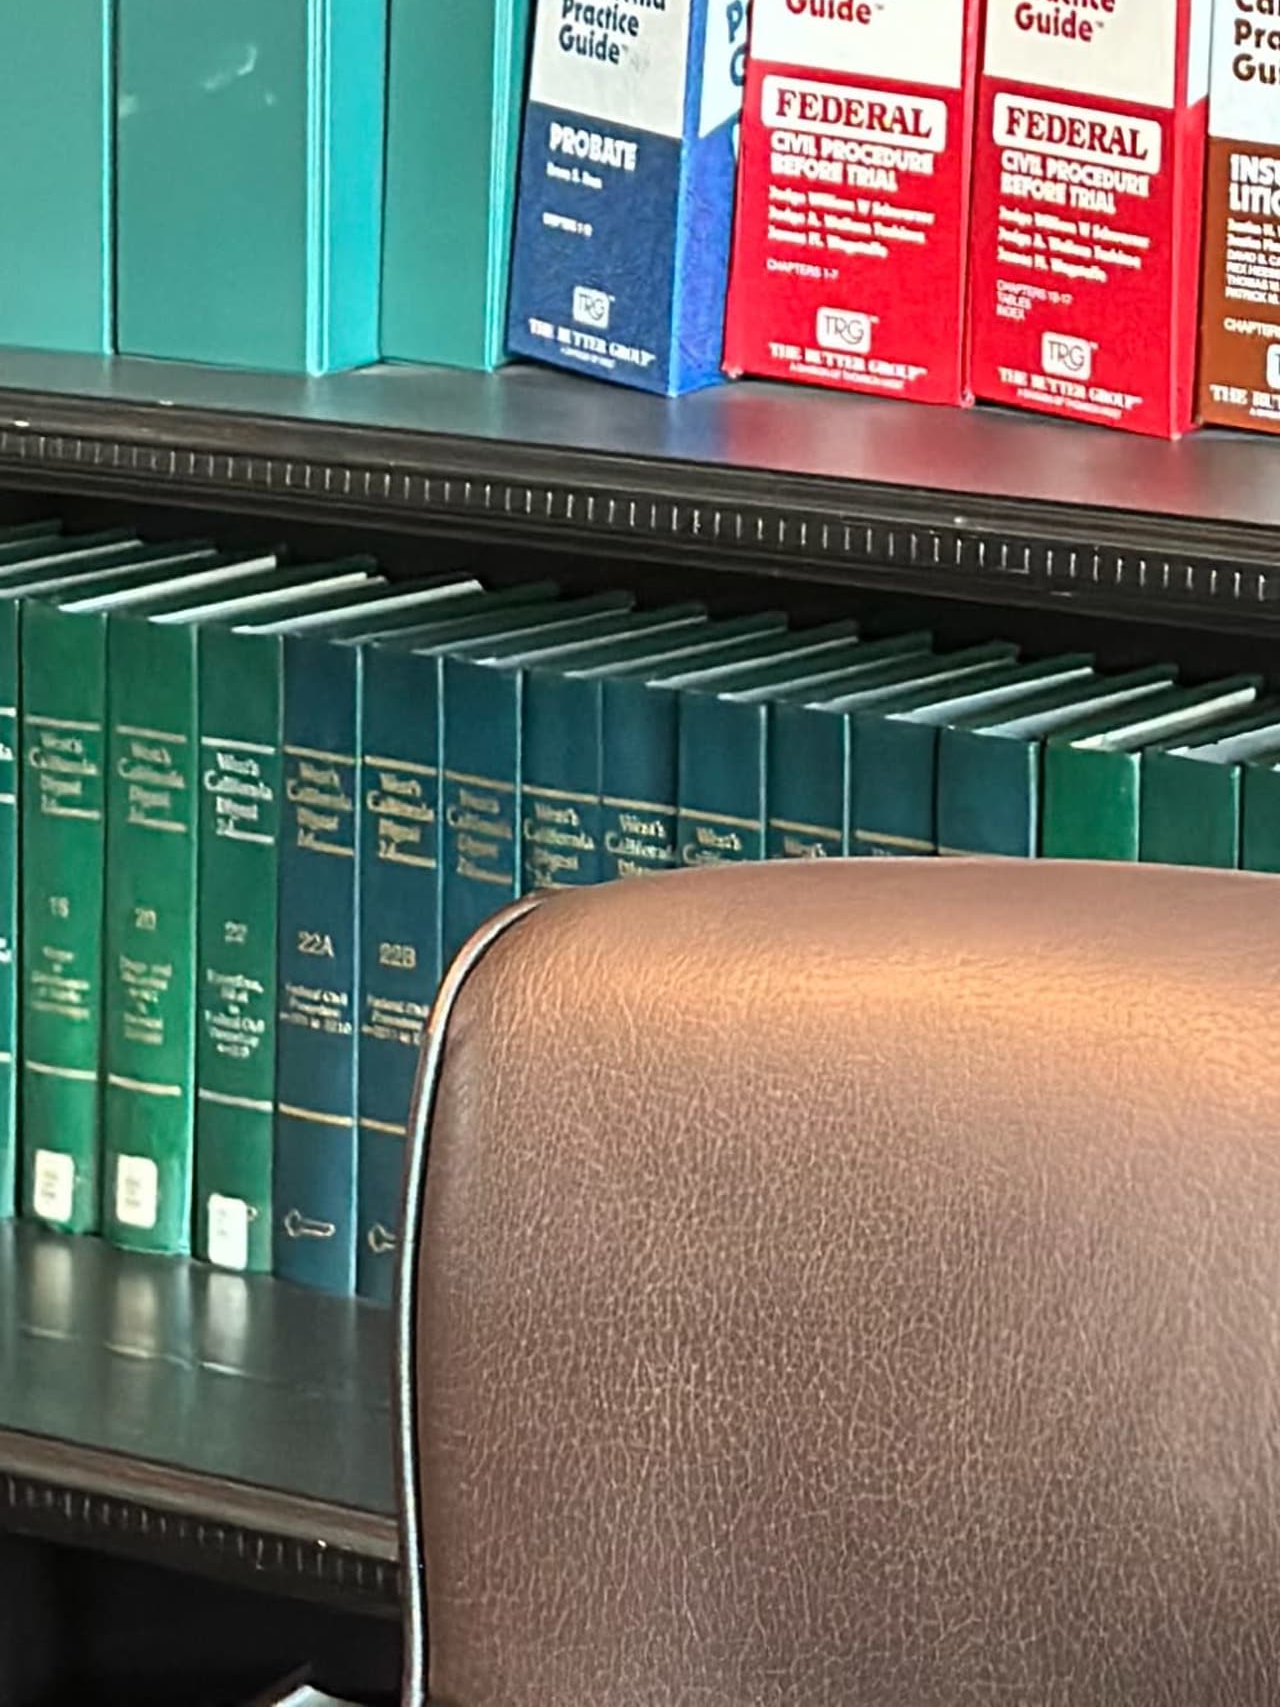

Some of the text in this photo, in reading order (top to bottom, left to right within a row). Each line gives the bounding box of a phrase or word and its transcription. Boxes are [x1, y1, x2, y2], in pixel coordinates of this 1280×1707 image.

[1015, 4, 1093, 42] Guide
[559, 25, 620, 65] Guide
[776, 89, 932, 138] FEDERAL
[1005, 107, 1148, 160] FEDERAL
[549, 123, 637, 171] PROBATE
[771, 132, 934, 174] CIVIL PROCEDURE
[771, 156, 898, 192] BEFORE TRIAL
[1001, 148, 1149, 197] CIVIL PROCEDURE
[1001, 173, 1116, 214] BEFORE TRIAL
[824, 315, 864, 345] TRG
[1049, 340, 1085, 370] TRG
